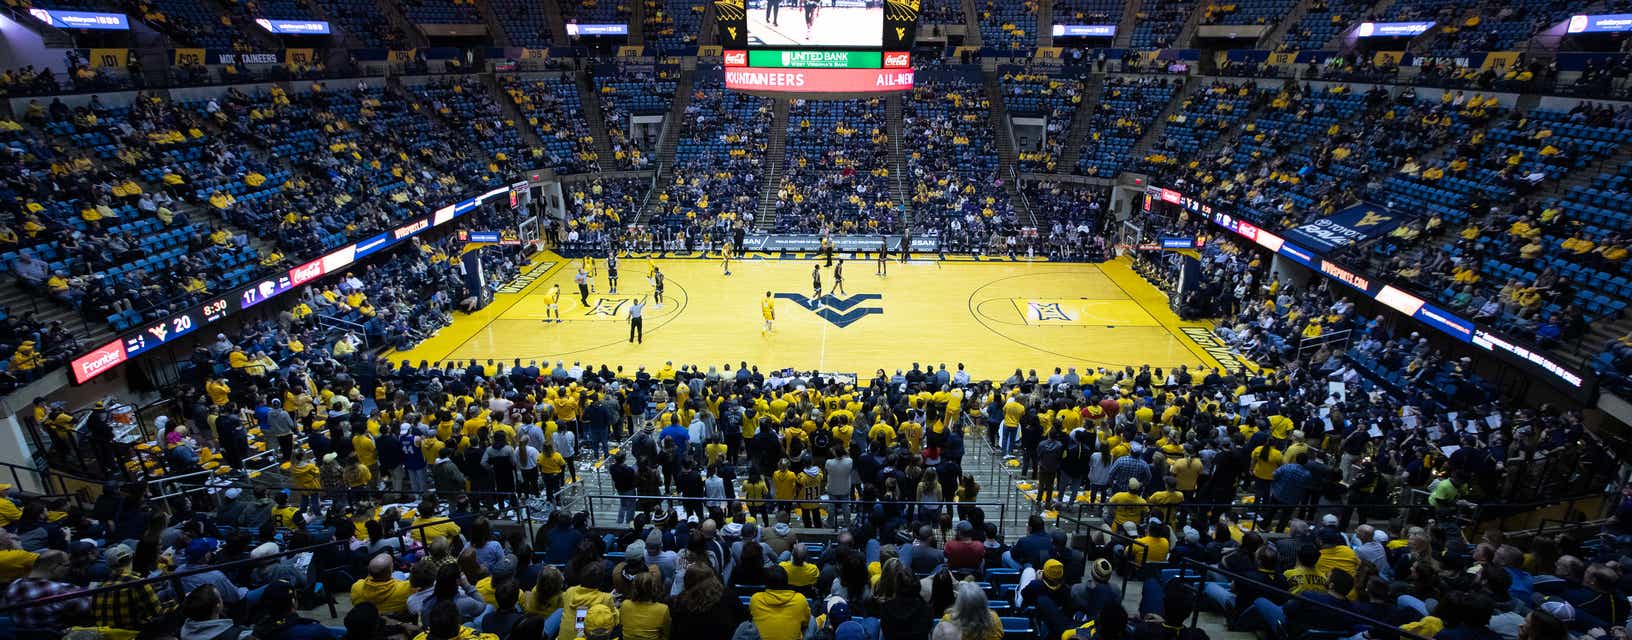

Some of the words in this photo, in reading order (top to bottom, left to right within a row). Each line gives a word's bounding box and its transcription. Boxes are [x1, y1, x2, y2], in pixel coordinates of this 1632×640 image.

[791, 52, 823, 60] UNITED
[824, 53, 848, 61] BANK
[243, 288, 256, 304] 17
[203, 299, 227, 316] 8:30
[174, 315, 191, 333] 20
[82, 350, 119, 373] Frontier
